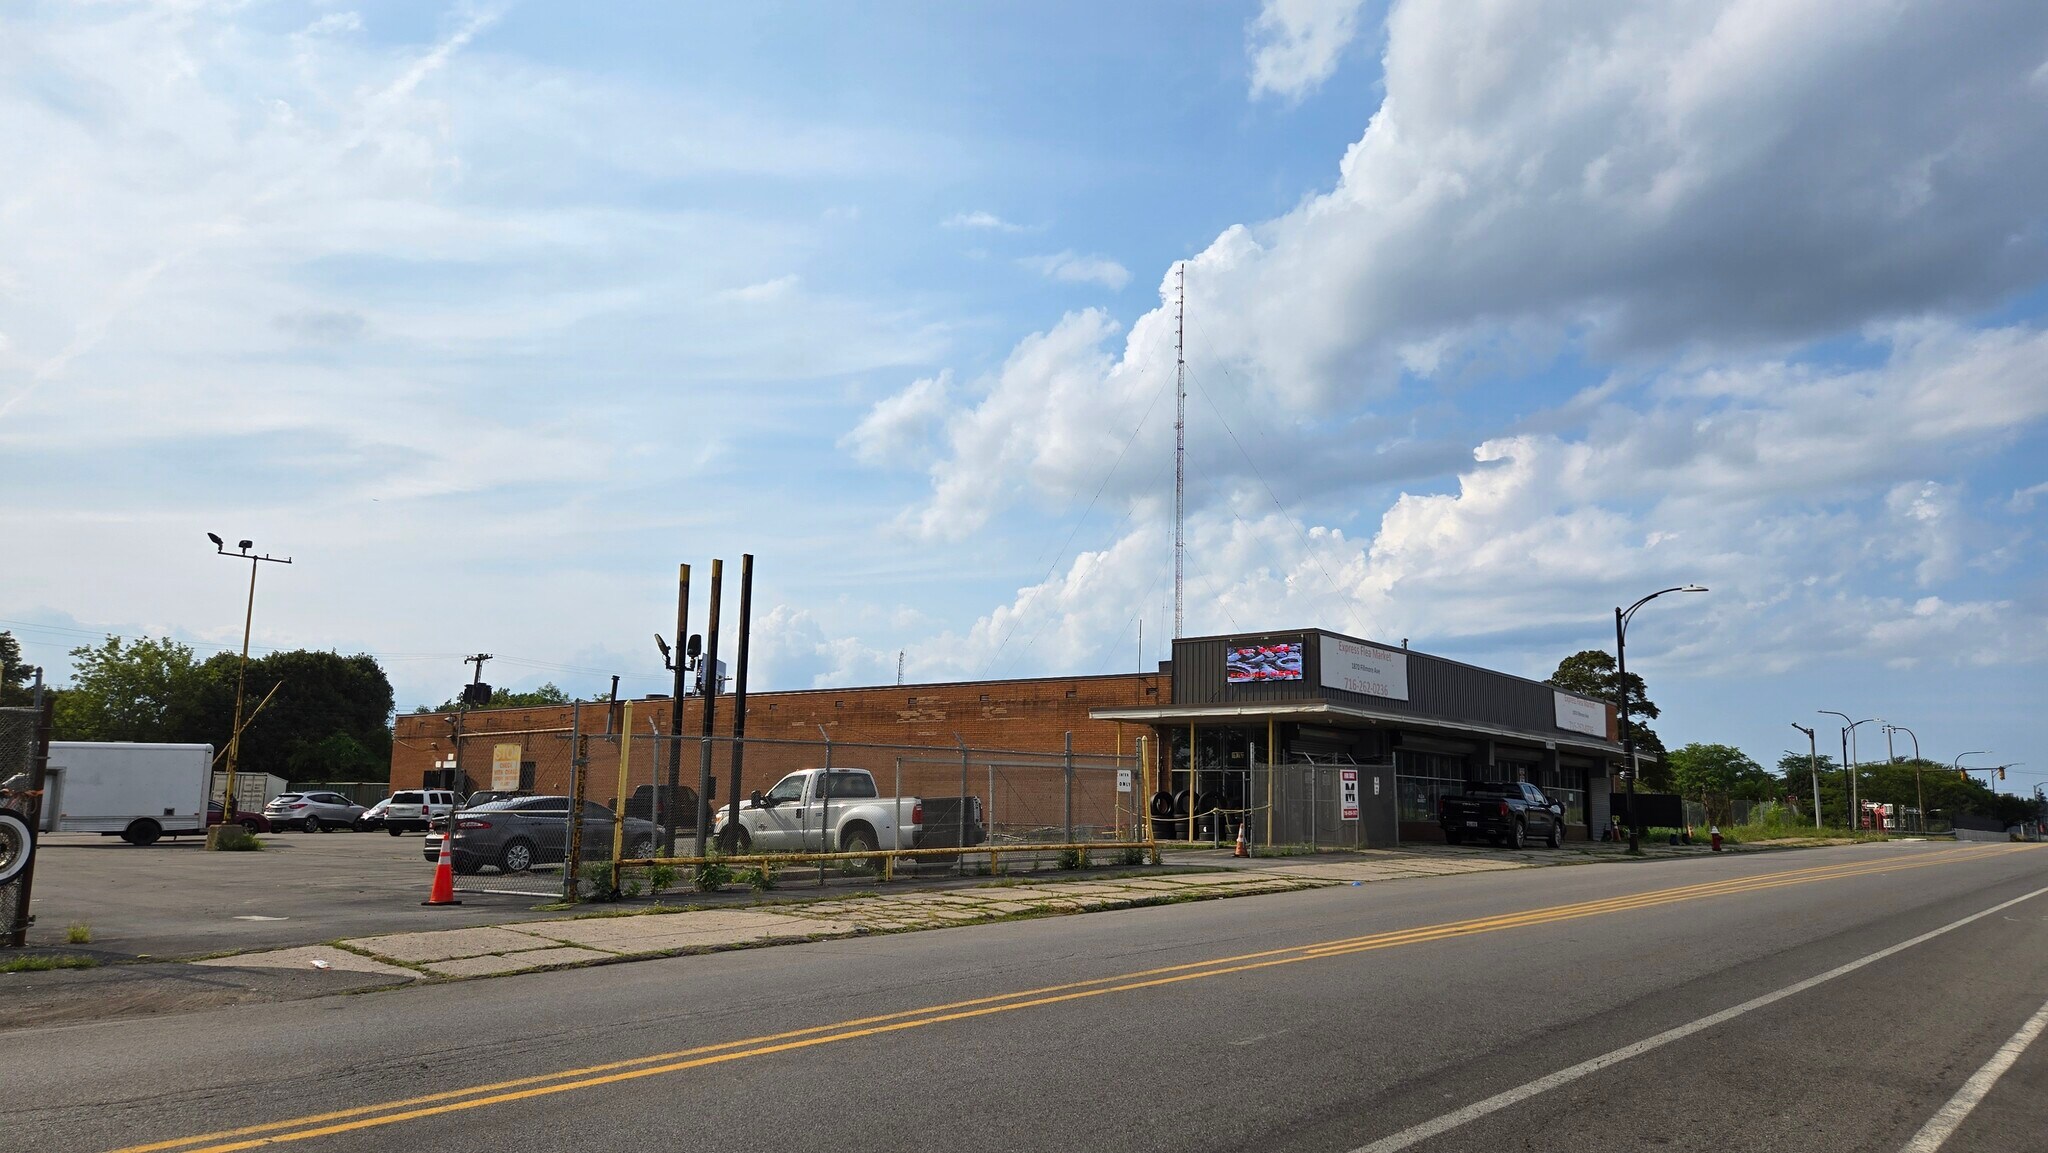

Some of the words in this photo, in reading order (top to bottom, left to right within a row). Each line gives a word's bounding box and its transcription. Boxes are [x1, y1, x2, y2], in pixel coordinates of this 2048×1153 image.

[1338, 641, 1360, 655] Express
[1360, 645, 1372, 658] Flea
[1372, 648, 1392, 662] Market
[1230, 670, 1267, 678] FOUND
[1344, 677, 1389, 696] 716-262-0236
